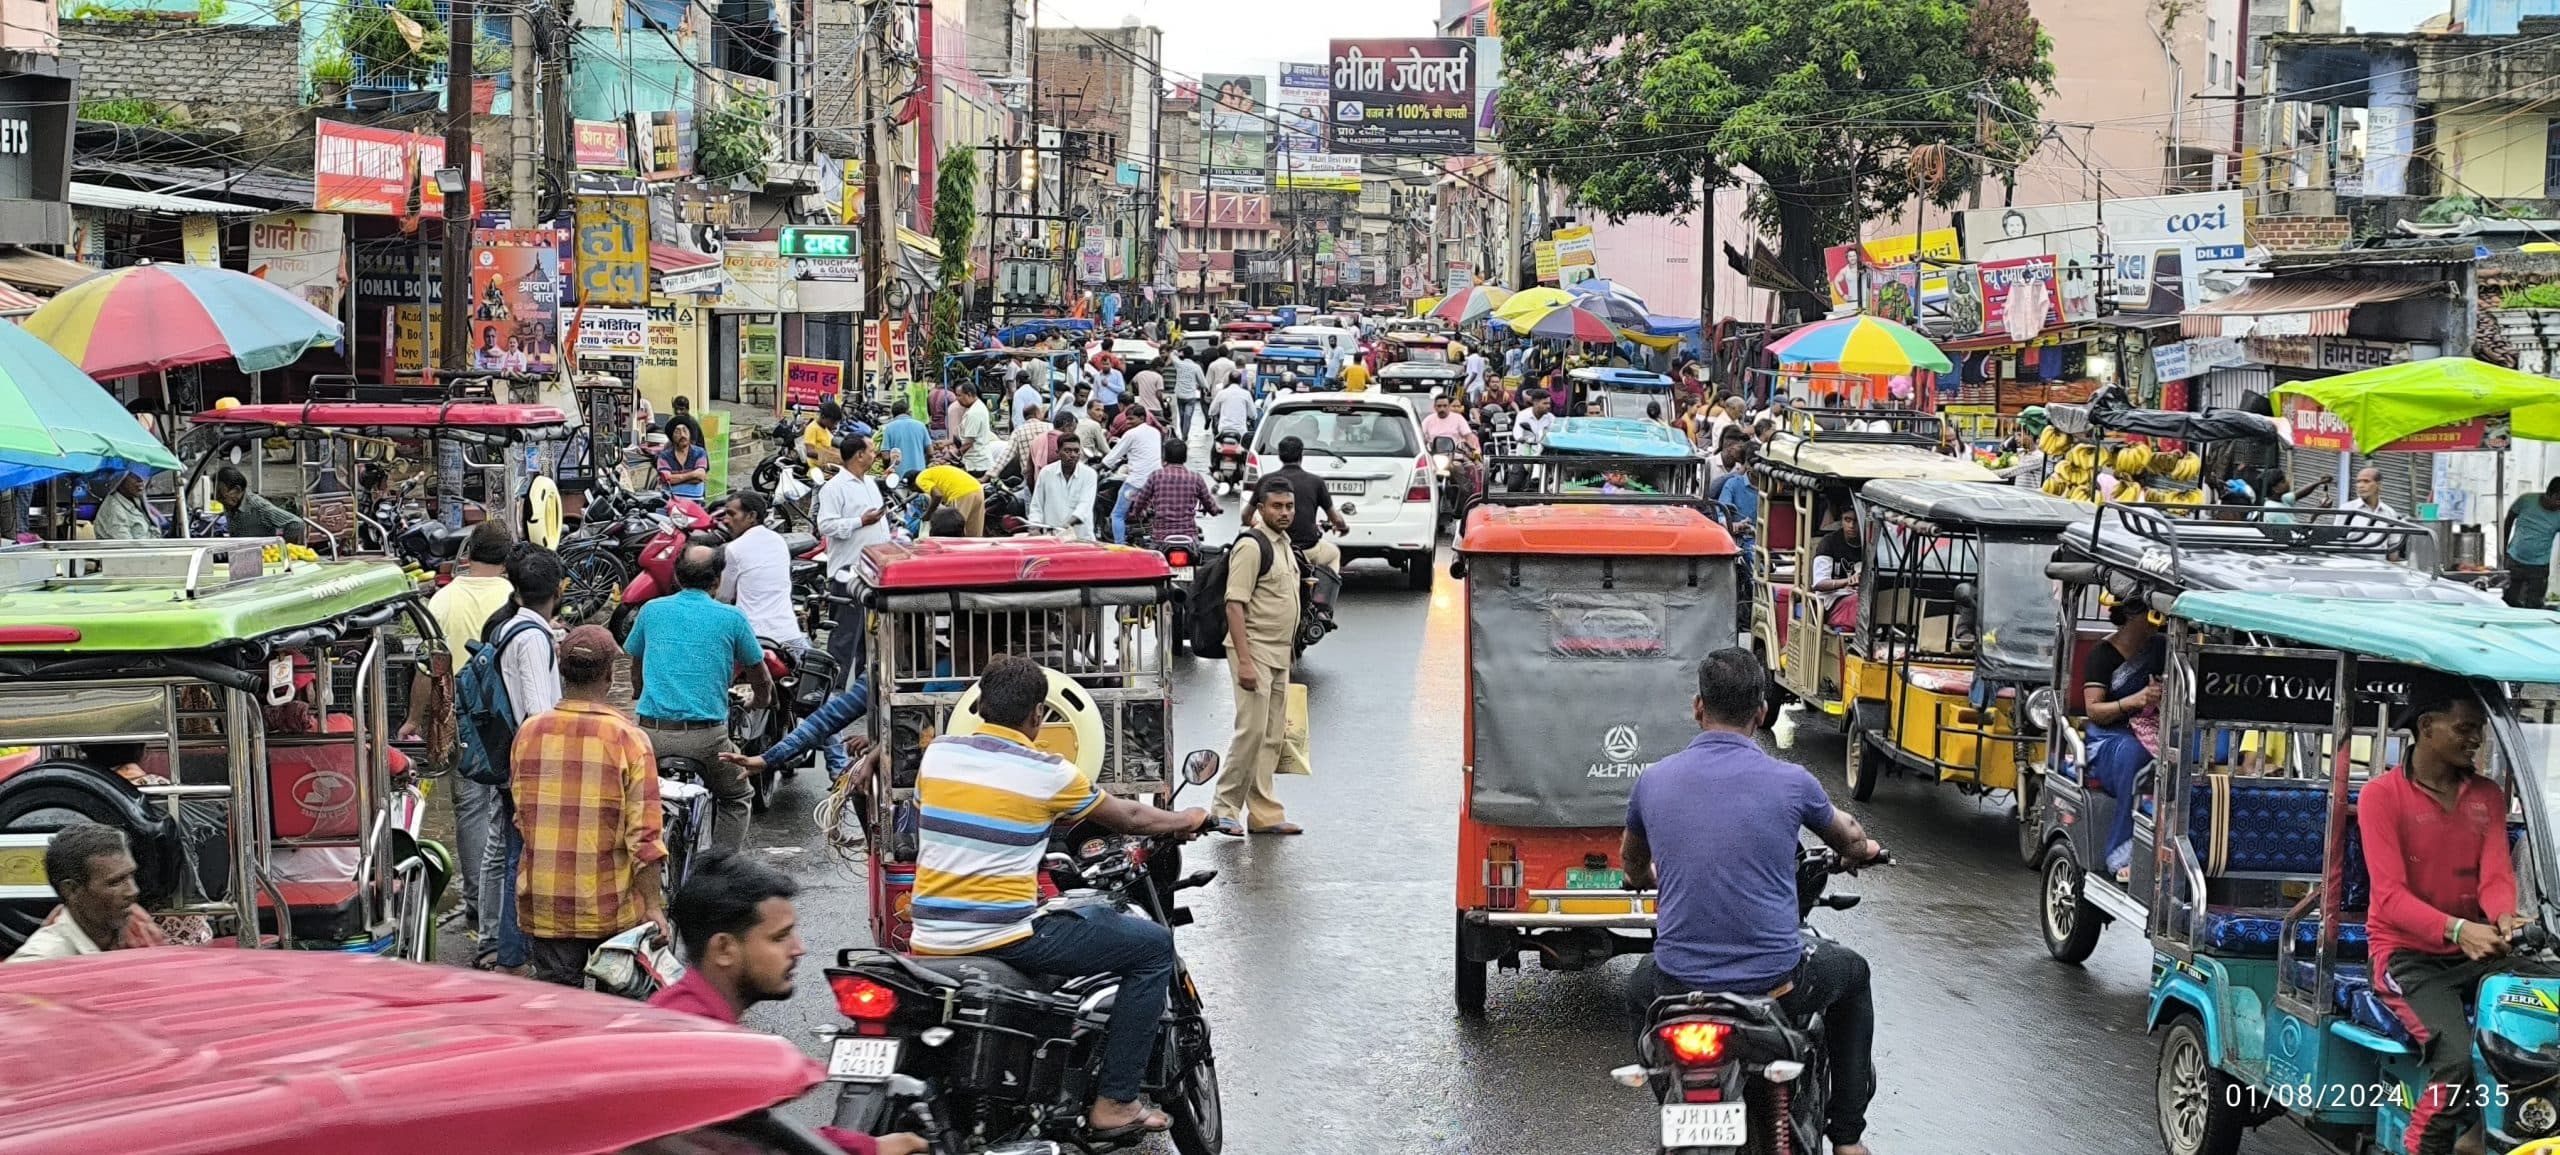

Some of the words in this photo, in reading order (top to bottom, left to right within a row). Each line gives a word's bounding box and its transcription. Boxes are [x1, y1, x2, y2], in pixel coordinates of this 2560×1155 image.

[1335, 46, 1385, 91] भीम
[1390, 47, 1468, 94] ज्वेलर्स
[1396, 104, 1430, 119] 100%
[320, 135, 355, 176] ARYAN
[356, 140, 403, 181] PRINTERS
[2167, 203, 2230, 233] cozi
[254, 218, 296, 251] शादी
[803, 233, 850, 254] टावर
[2197, 248, 2218, 260] DIL
[2220, 247, 2234, 258] KI
[812, 258, 843, 267] TOUCH
[828, 265, 855, 275] GLOW
[2118, 255, 2146, 280] KEI
[402, 310, 441, 323] Acadmic
[2324, 343, 2354, 366] होम
[2504, 994, 2544, 1008] TERRA
[844, 1041, 888, 1057] JH11A
[1677, 1109, 1732, 1125] JH11A
